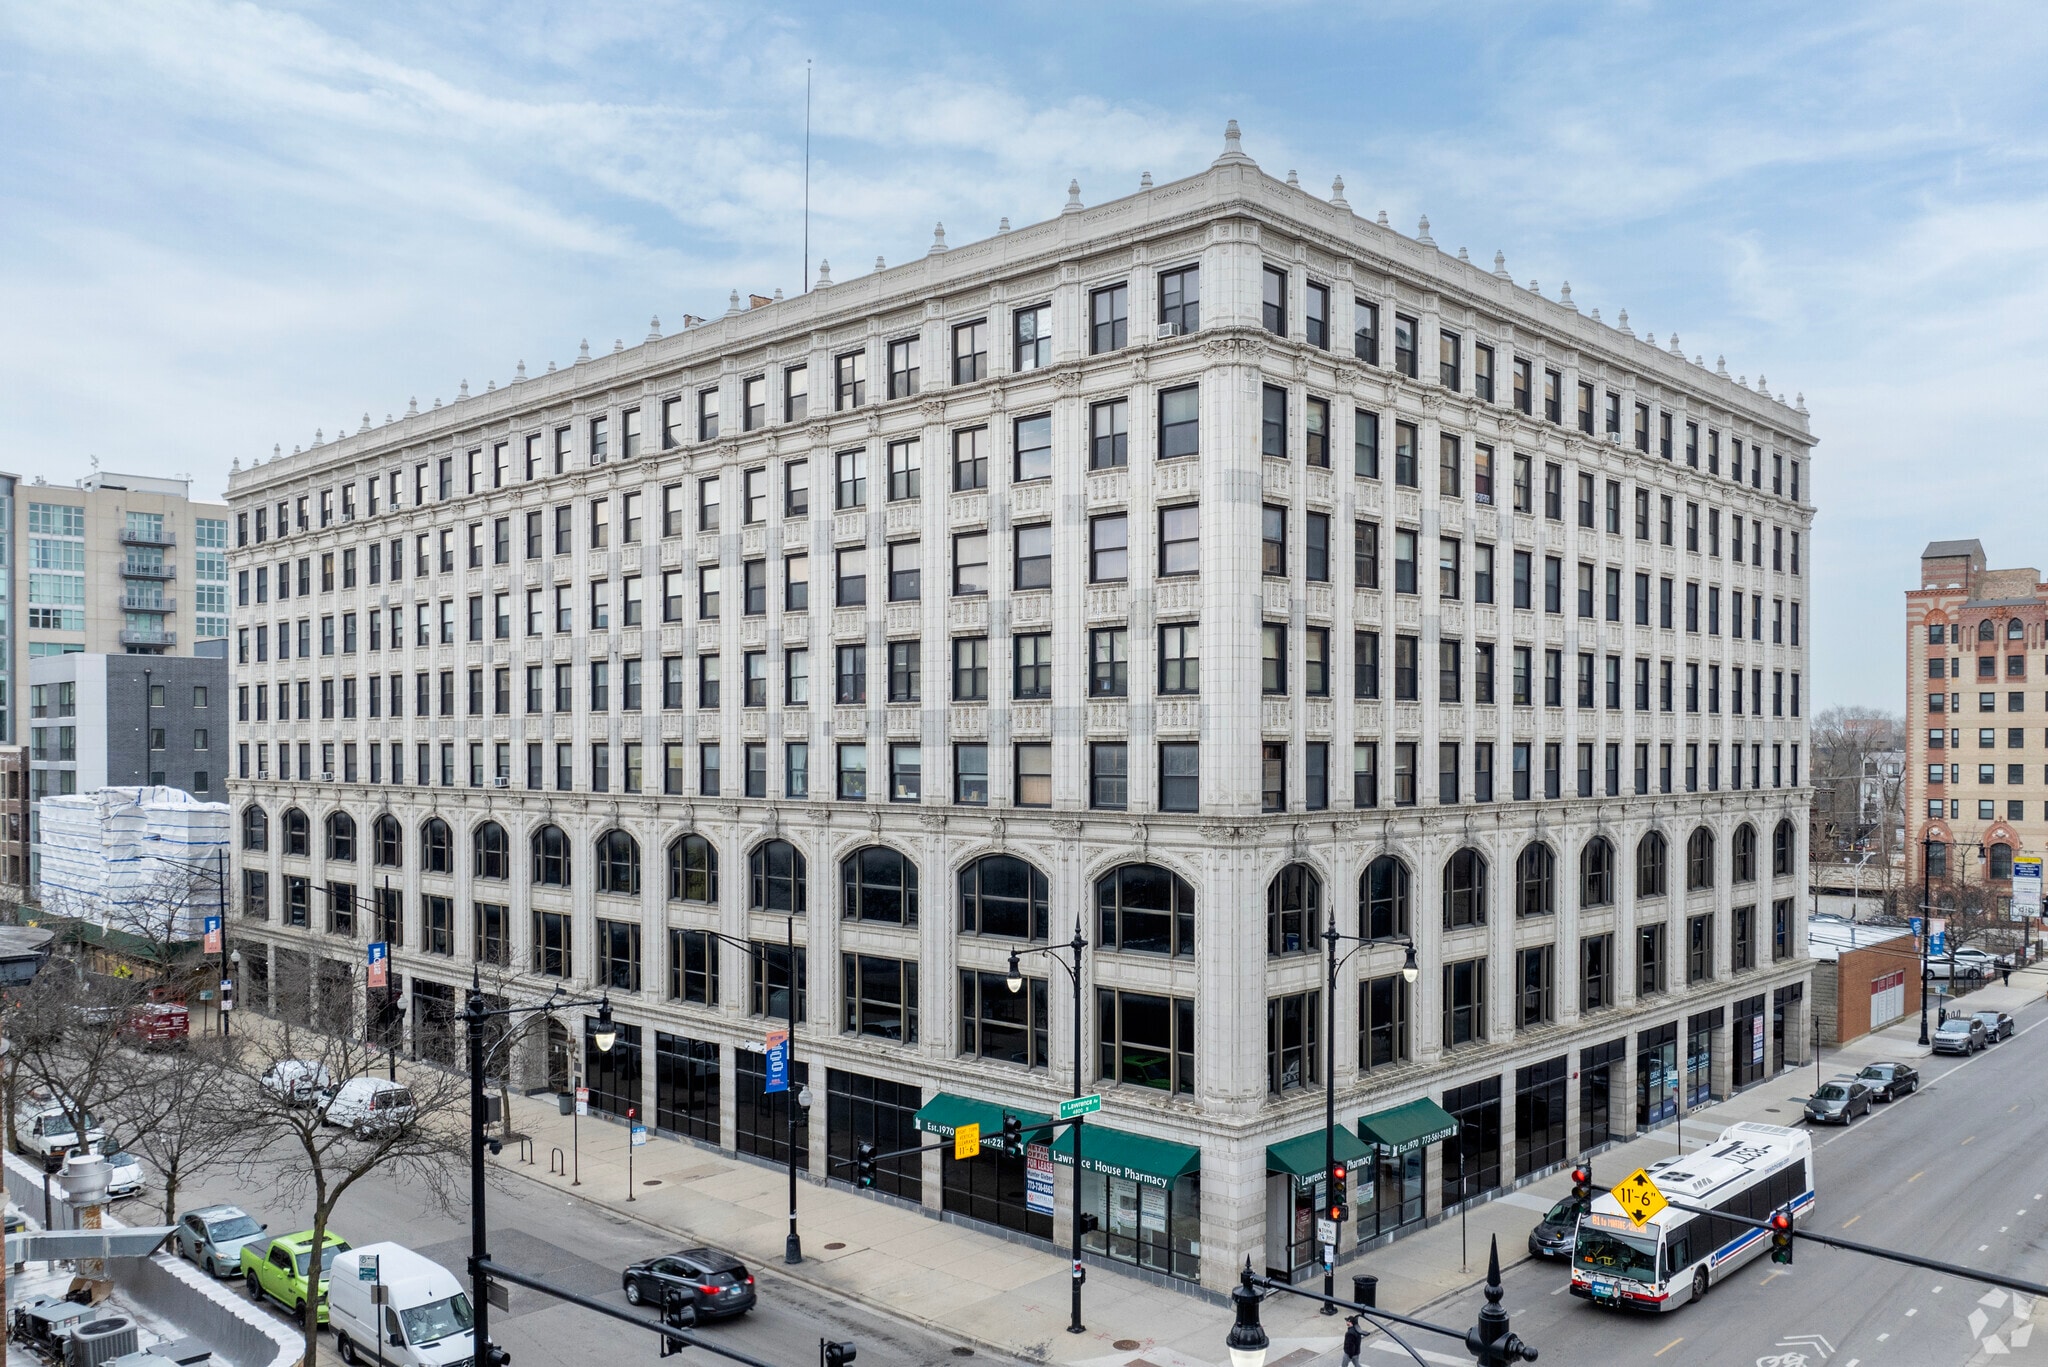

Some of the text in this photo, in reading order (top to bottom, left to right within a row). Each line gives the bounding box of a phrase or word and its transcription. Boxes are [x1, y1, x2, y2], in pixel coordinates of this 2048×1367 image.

[1067, 1099, 1093, 1110] Lawrence
[927, 1122, 955, 1136] Est.1970
[1399, 1139, 1419, 1153] Est.1970
[1027, 1158, 1053, 1173] FOR LEASE
[1053, 1150, 1168, 1188] Lawrce House Pharmacy
[1301, 1155, 1372, 1186] Lawrence Pharmacy
[1621, 1187, 1656, 1207] 11'-6"
